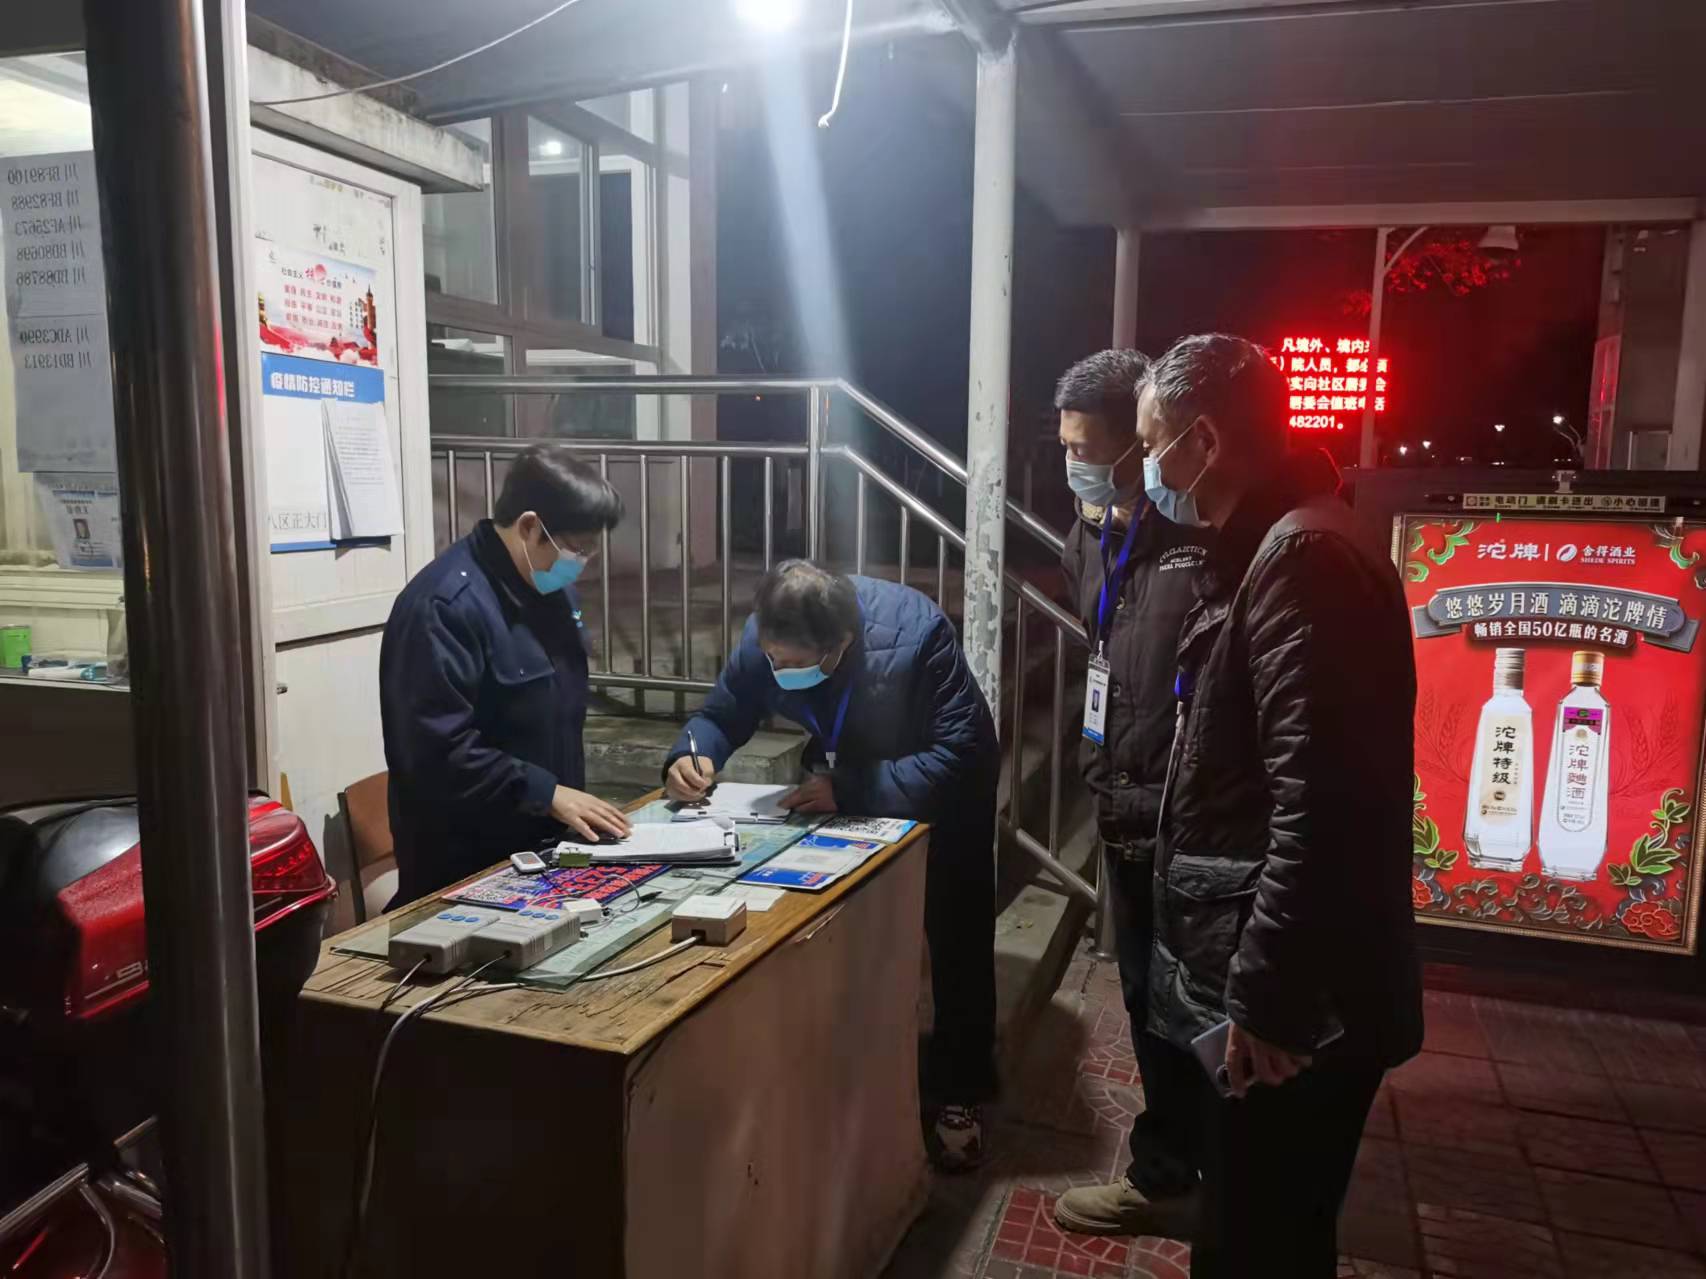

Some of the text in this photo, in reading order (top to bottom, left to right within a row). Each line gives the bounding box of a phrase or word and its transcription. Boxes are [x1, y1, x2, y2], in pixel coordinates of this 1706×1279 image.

[1477, 543, 1636, 561] 沱牌 舍得酒业
[1445, 592, 1668, 630] 悠悠岁月酒 滴滴沱牌情
[1474, 621, 1629, 645] 畅销全国50亿瓶的名酒
[1492, 726, 1516, 785] 沱牌特级
